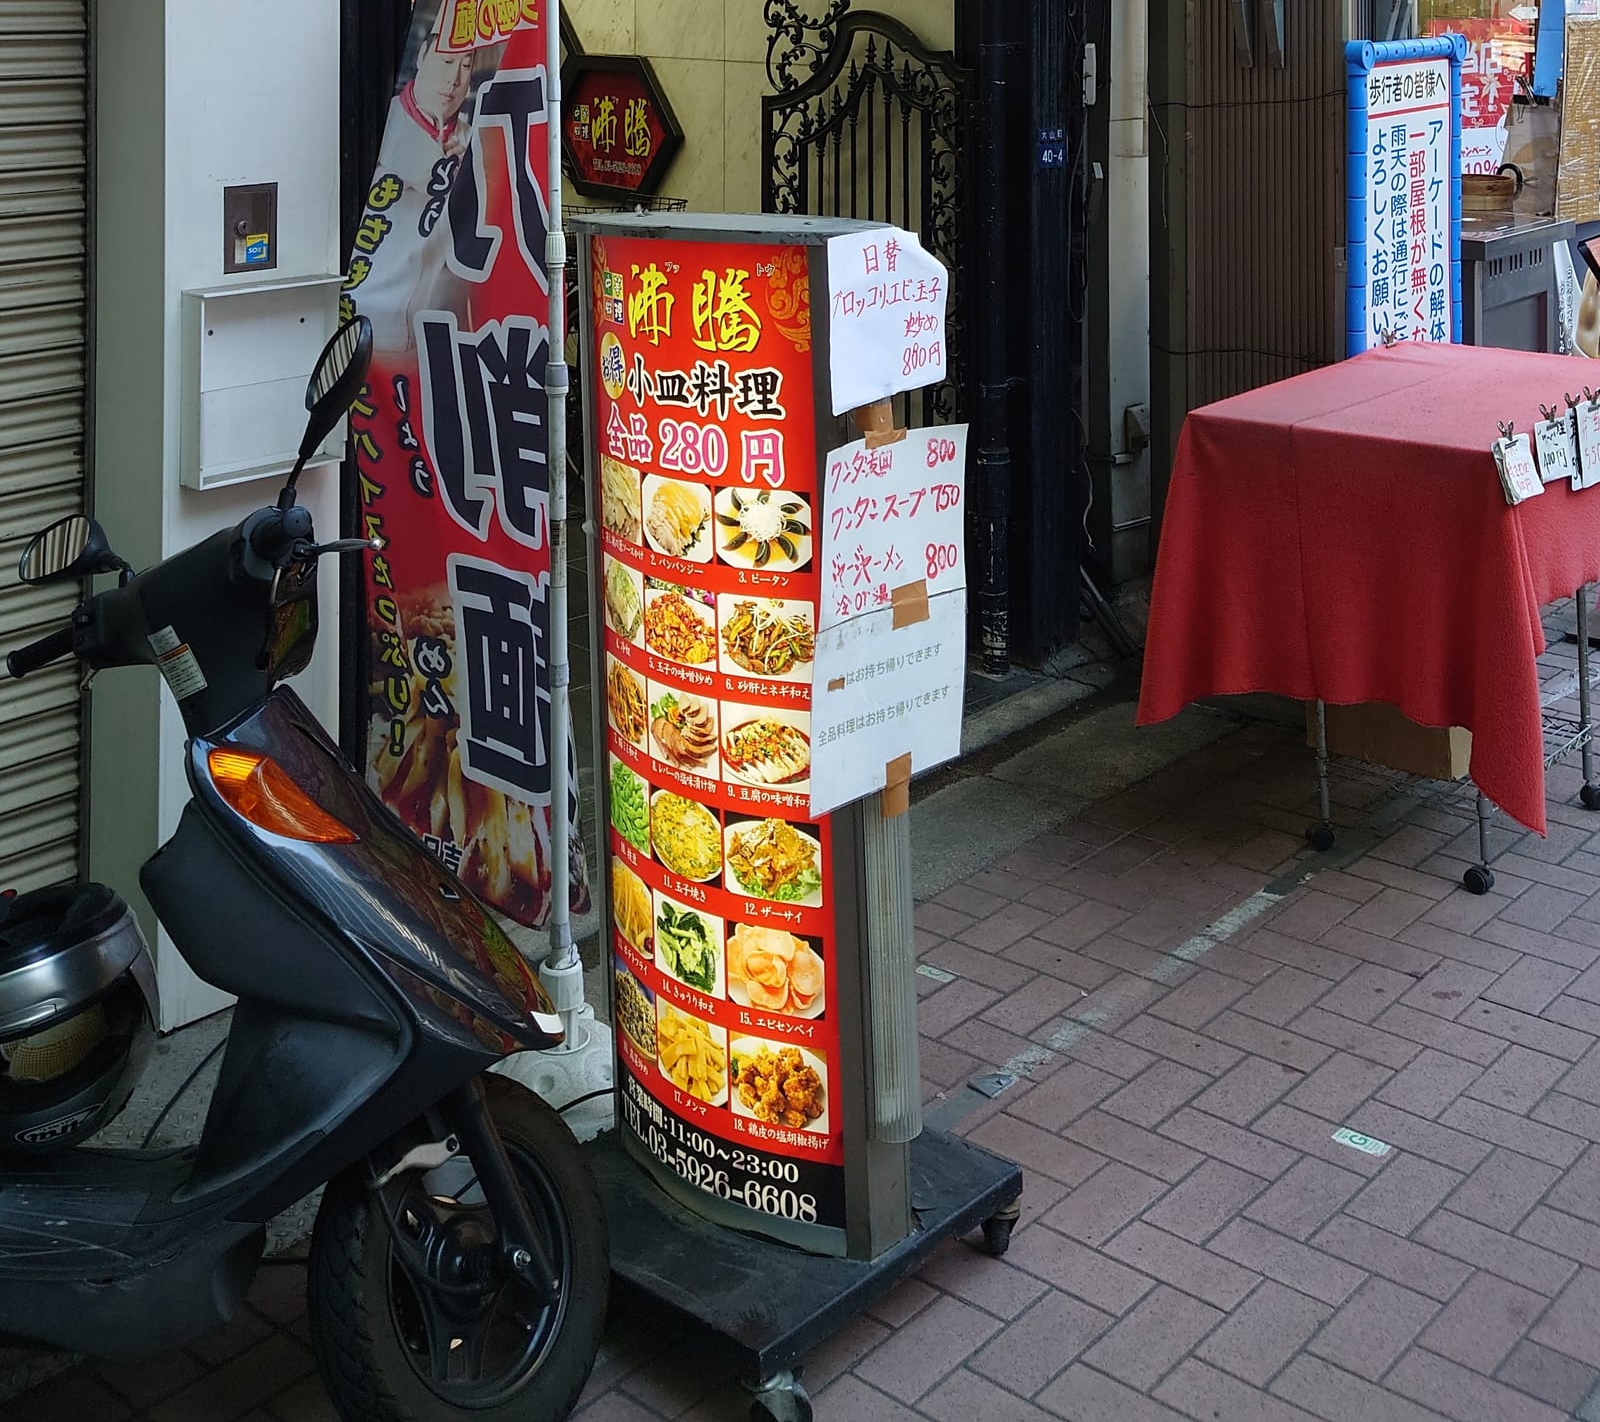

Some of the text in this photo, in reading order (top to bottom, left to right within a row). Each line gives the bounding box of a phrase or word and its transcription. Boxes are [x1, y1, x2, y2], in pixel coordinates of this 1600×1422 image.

[1368, 68, 1446, 108] 歩行者の皆様へ
[1042, 148, 1064, 163] 40-4
[1370, 128, 1390, 348] よろしくお願い
[1428, 119, 1446, 343] アーケードの解体
[862, 237, 902, 275] 日替
[628, 354, 785, 419] 小皿料理
[606, 401, 786, 488] 全品 280 円
[930, 483, 960, 513] 750
[924, 542, 958, 580] 800
[738, 571, 747, 584] 3.
[725, 679, 811, 700] 6. 砂肝とネギ和え
[817, 685, 951, 747] 全品料理はお持ち帰りできます
[727, 784, 736, 797] 9.
[663, 874, 707, 903] 11. 玉子焼き
[744, 901, 802, 924] 12. ザーサイ
[673, 984, 716, 1016] きゅうり和え
[739, 1010, 753, 1026] 15.
[673, 1089, 708, 1117] 17. メンマ
[733, 1117, 746, 1132] 18.
[621, 1089, 818, 1225] TEL.03-5926-6608
